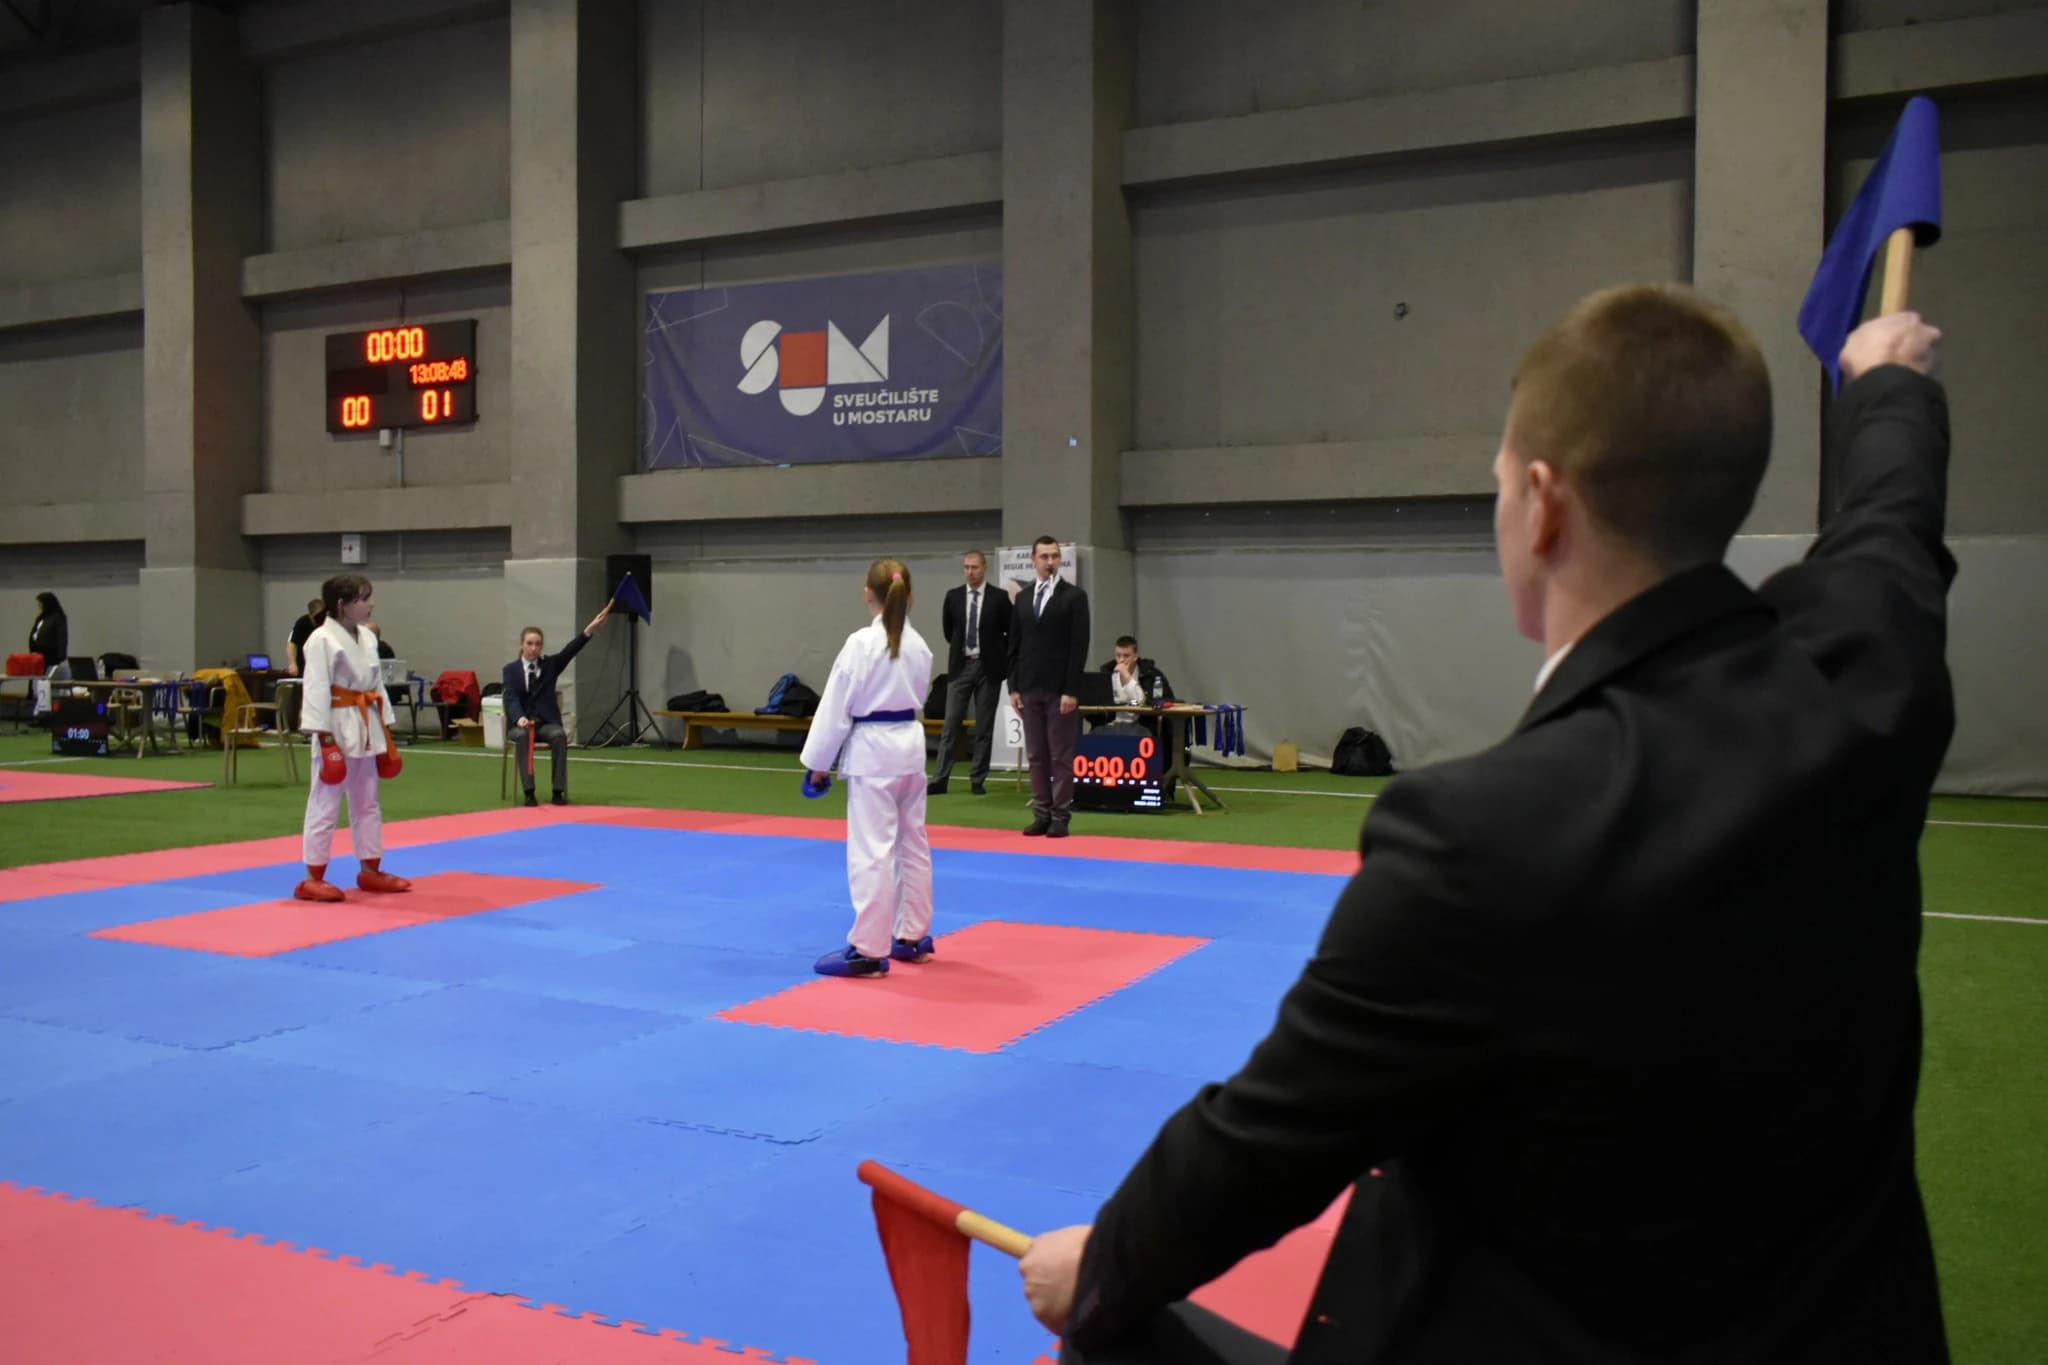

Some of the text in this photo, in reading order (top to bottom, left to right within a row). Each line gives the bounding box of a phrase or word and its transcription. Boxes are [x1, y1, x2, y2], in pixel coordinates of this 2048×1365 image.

[367, 327, 424, 362] 00:00
[422, 390, 451, 420] 01
[833, 387, 939, 408] SVEUČILIŠTE
[343, 396, 370, 427] 00
[833, 408, 931, 425] U MOSTARU
[1009, 718, 1022, 744] 3
[1138, 737, 1155, 759] 0
[1072, 755, 1146, 779] 0:00.0
